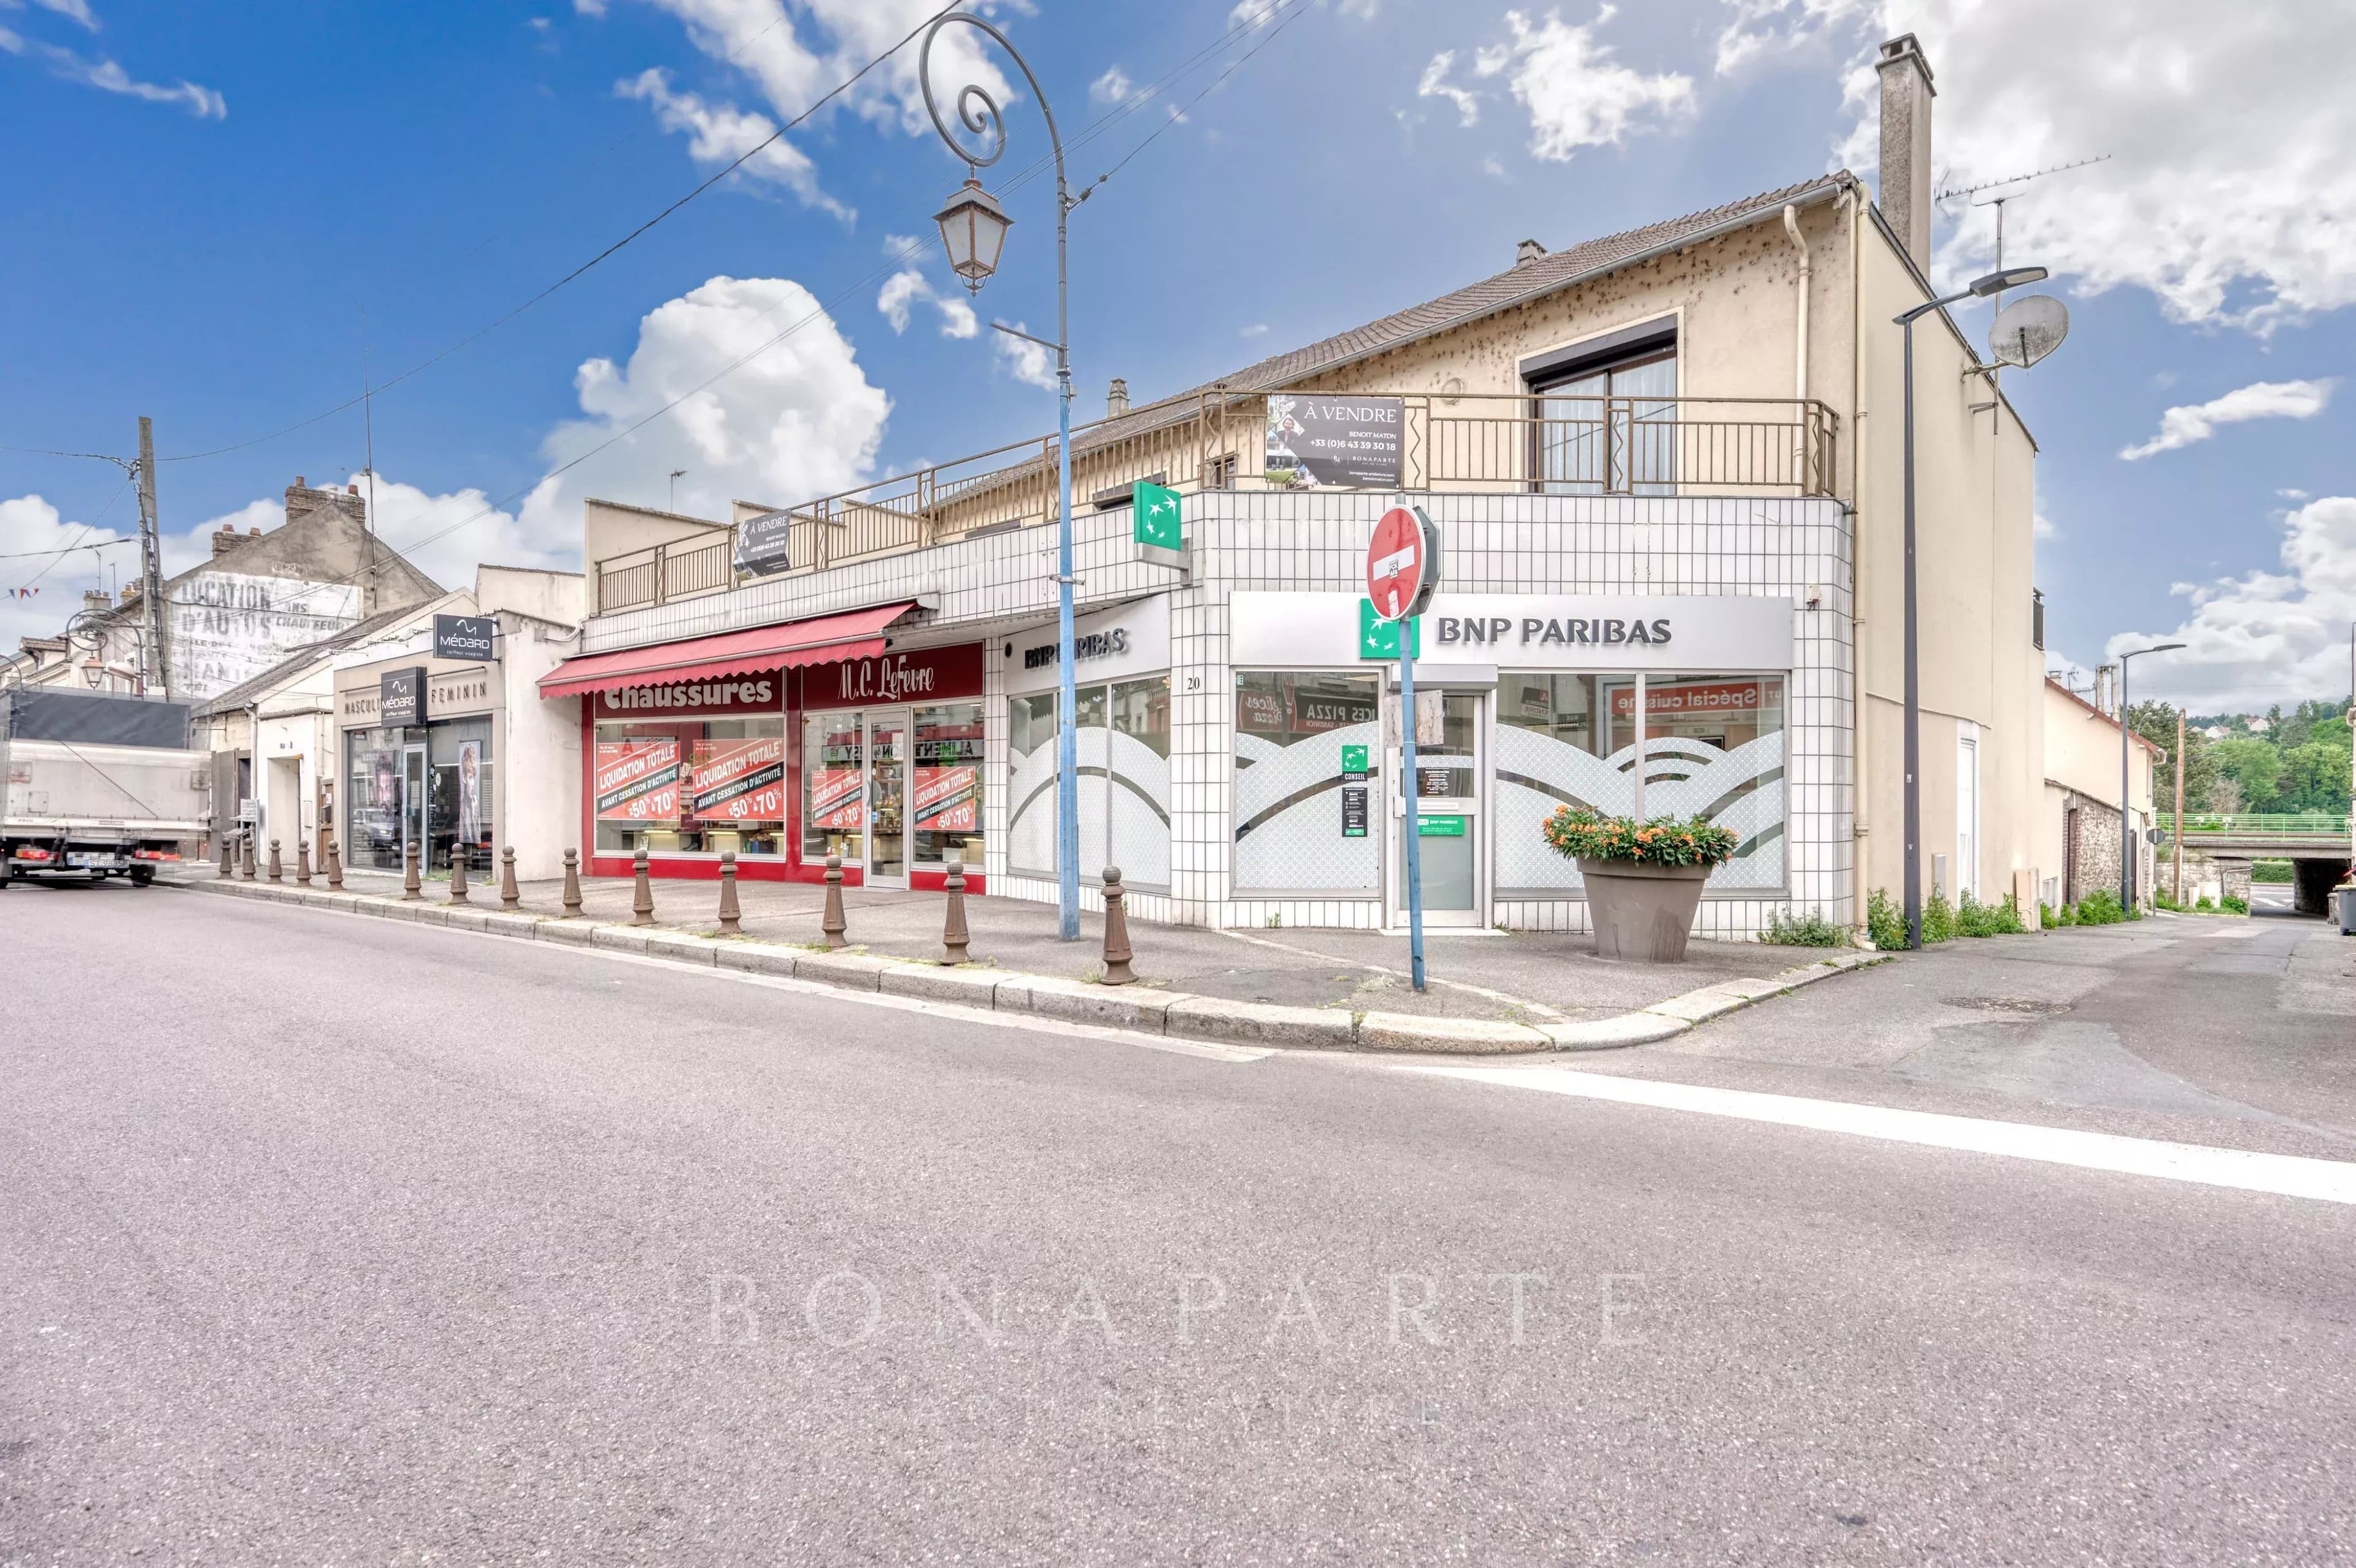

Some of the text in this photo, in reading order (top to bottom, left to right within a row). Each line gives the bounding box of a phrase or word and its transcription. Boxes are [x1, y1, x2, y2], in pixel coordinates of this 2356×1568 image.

[1304, 401, 1396, 423] À VENDRE
[1328, 440, 1345, 448] (0)6
[758, 516, 787, 532] VENDRE
[1439, 617, 1672, 644] BNP PARIBAS
[1025, 645, 1054, 669] BNP
[431, 682, 487, 704] FEMININ
[604, 680, 772, 709] Chaussures
[1187, 677, 1199, 690] 20
[599, 757, 645, 790] LIQUIDATION
[696, 756, 746, 790] LIQUIDATION
[601, 767, 676, 809] AVANT CESSATION D'ACTIVITÉ
[698, 766, 781, 809] AVANT CESSATION D'ACTIVITÉ
[813, 782, 842, 805] LIQUIDATION
[916, 779, 950, 805] LIQUIDATION
[917, 809, 930, 820] AVANT
[930, 799, 951, 814] CESSATION
